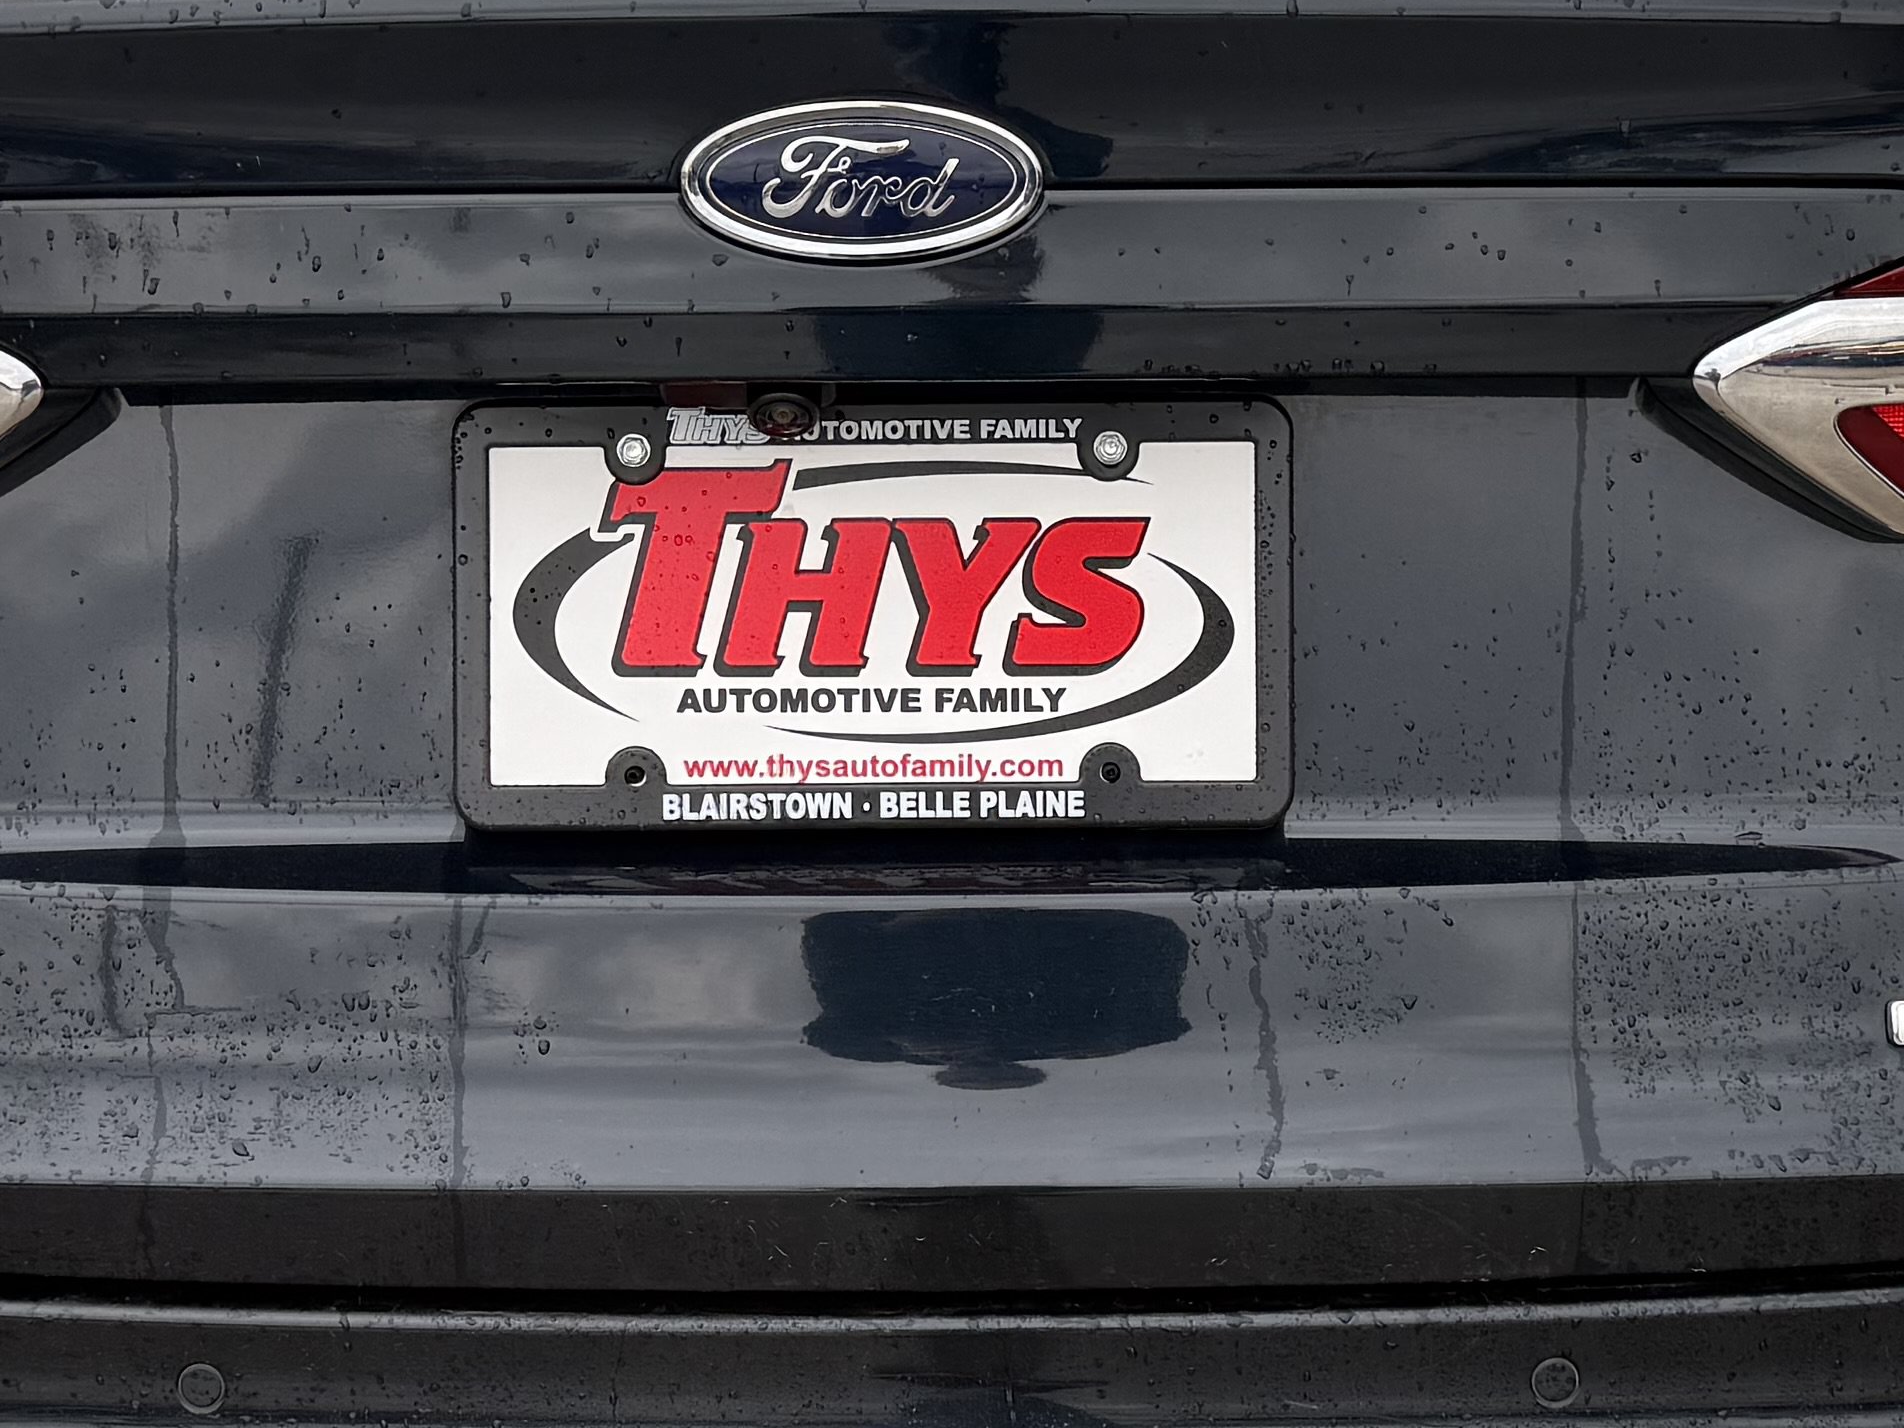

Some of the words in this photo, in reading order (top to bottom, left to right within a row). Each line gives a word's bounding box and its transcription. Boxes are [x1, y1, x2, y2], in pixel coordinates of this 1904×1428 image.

[761, 135, 960, 220] Ford
[784, 419, 969, 441] UTOMOTIVE
[980, 418, 1082, 439] FAMILY
[599, 459, 1151, 676] THYS
[676, 688, 921, 712] AUTOMOTIVE
[935, 687, 1067, 712] FAMILY
[684, 753, 1064, 784] www.thysautofamily.com
[662, 792, 853, 820] BLAIRSTOWN
[879, 791, 974, 819] BELLE
[980, 790, 1086, 818] PLAINE
